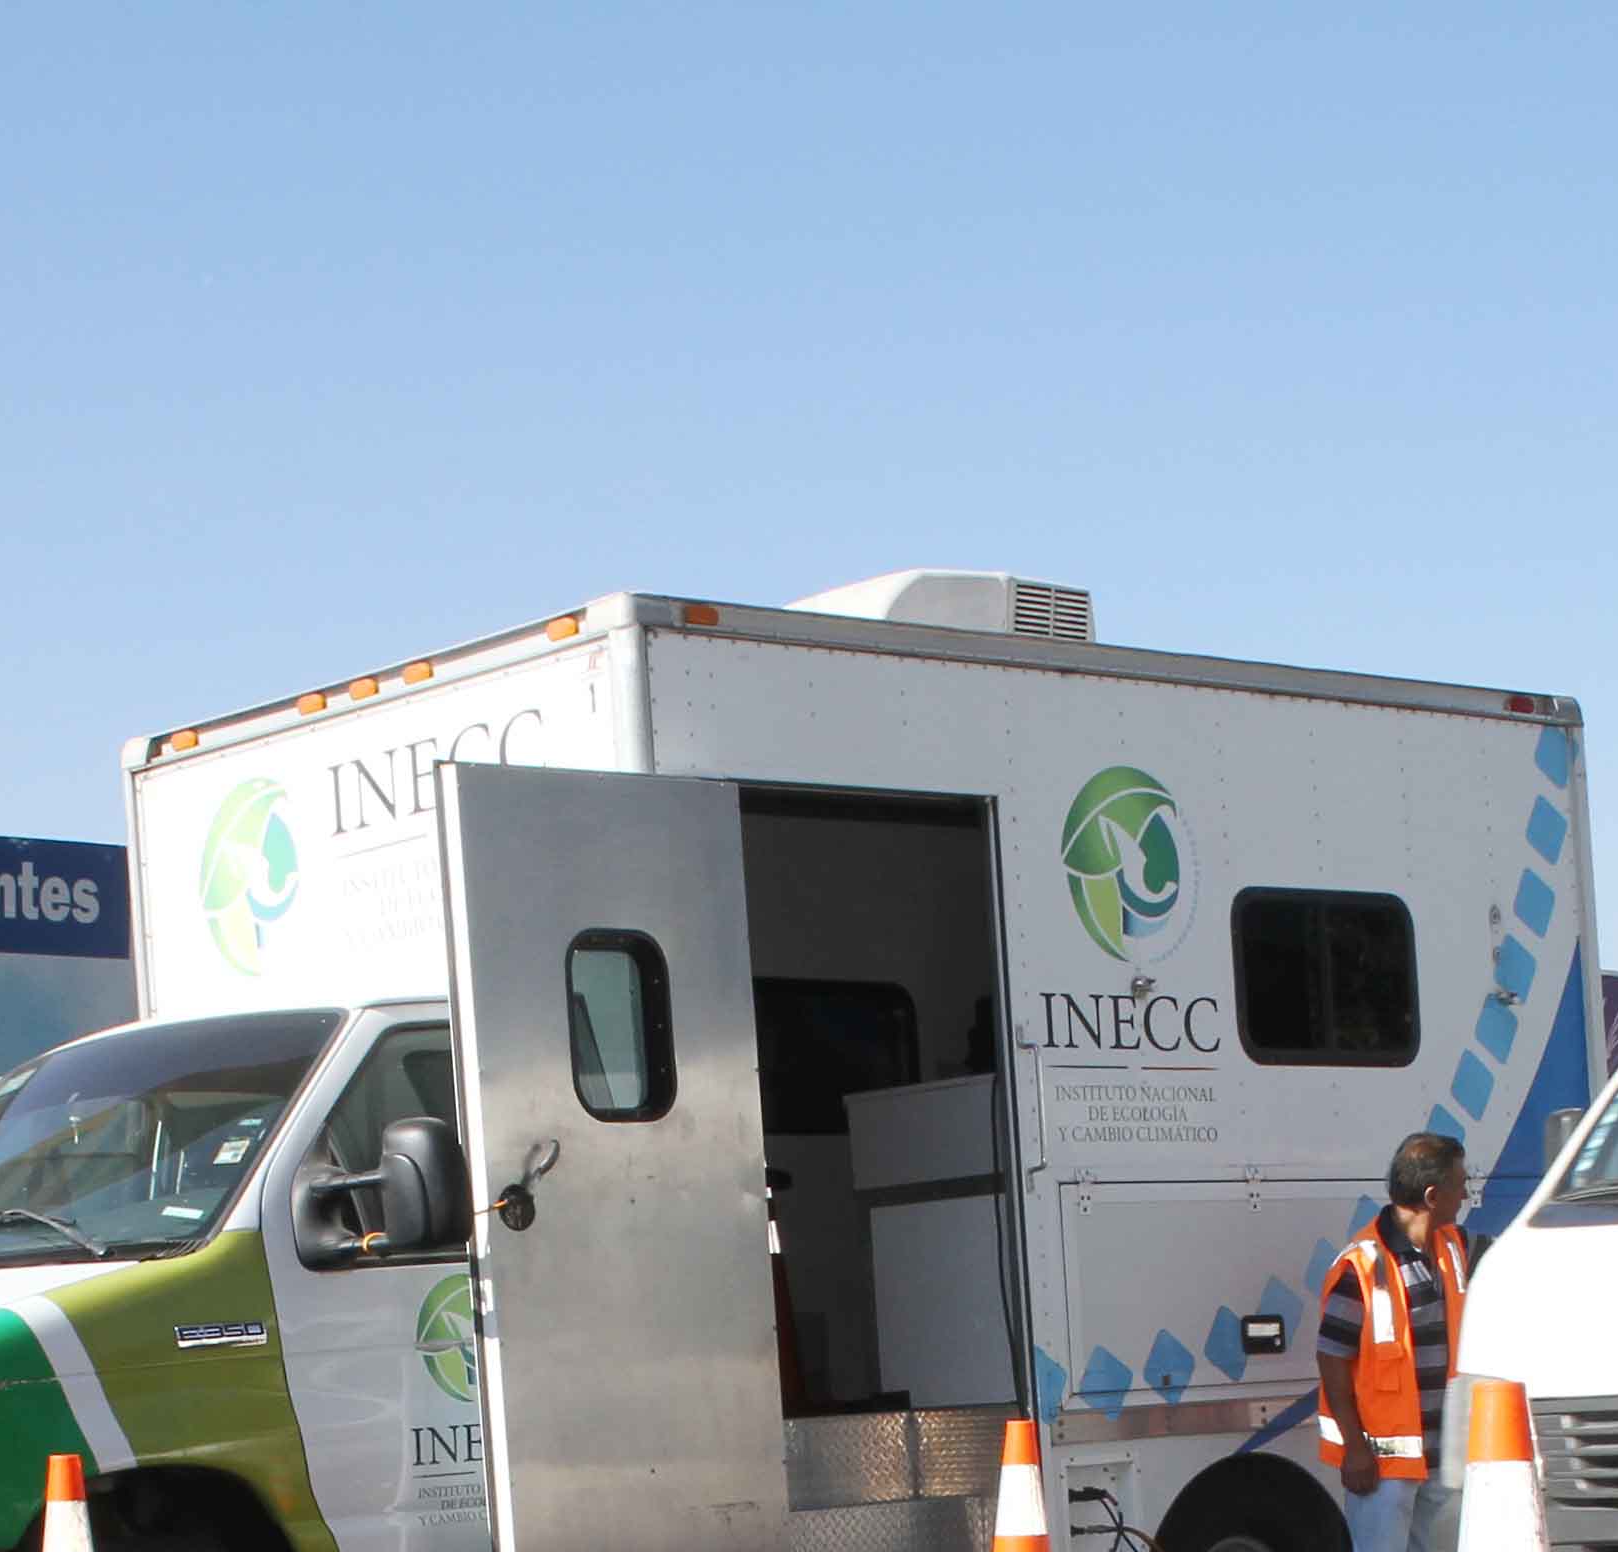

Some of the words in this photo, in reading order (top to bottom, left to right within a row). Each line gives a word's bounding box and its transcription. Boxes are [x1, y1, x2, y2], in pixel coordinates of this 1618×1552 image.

[1039, 992, 1221, 1053] INECC
[1055, 1085, 1136, 1102] INSTITUTO
[1141, 1085, 1216, 1103] NACIONAL
[1088, 1104, 1109, 1121] DE
[1058, 1127, 1070, 1142] Y
[1072, 1126, 1133, 1143] CAMBIO
[411, 1423, 485, 1467] INE
